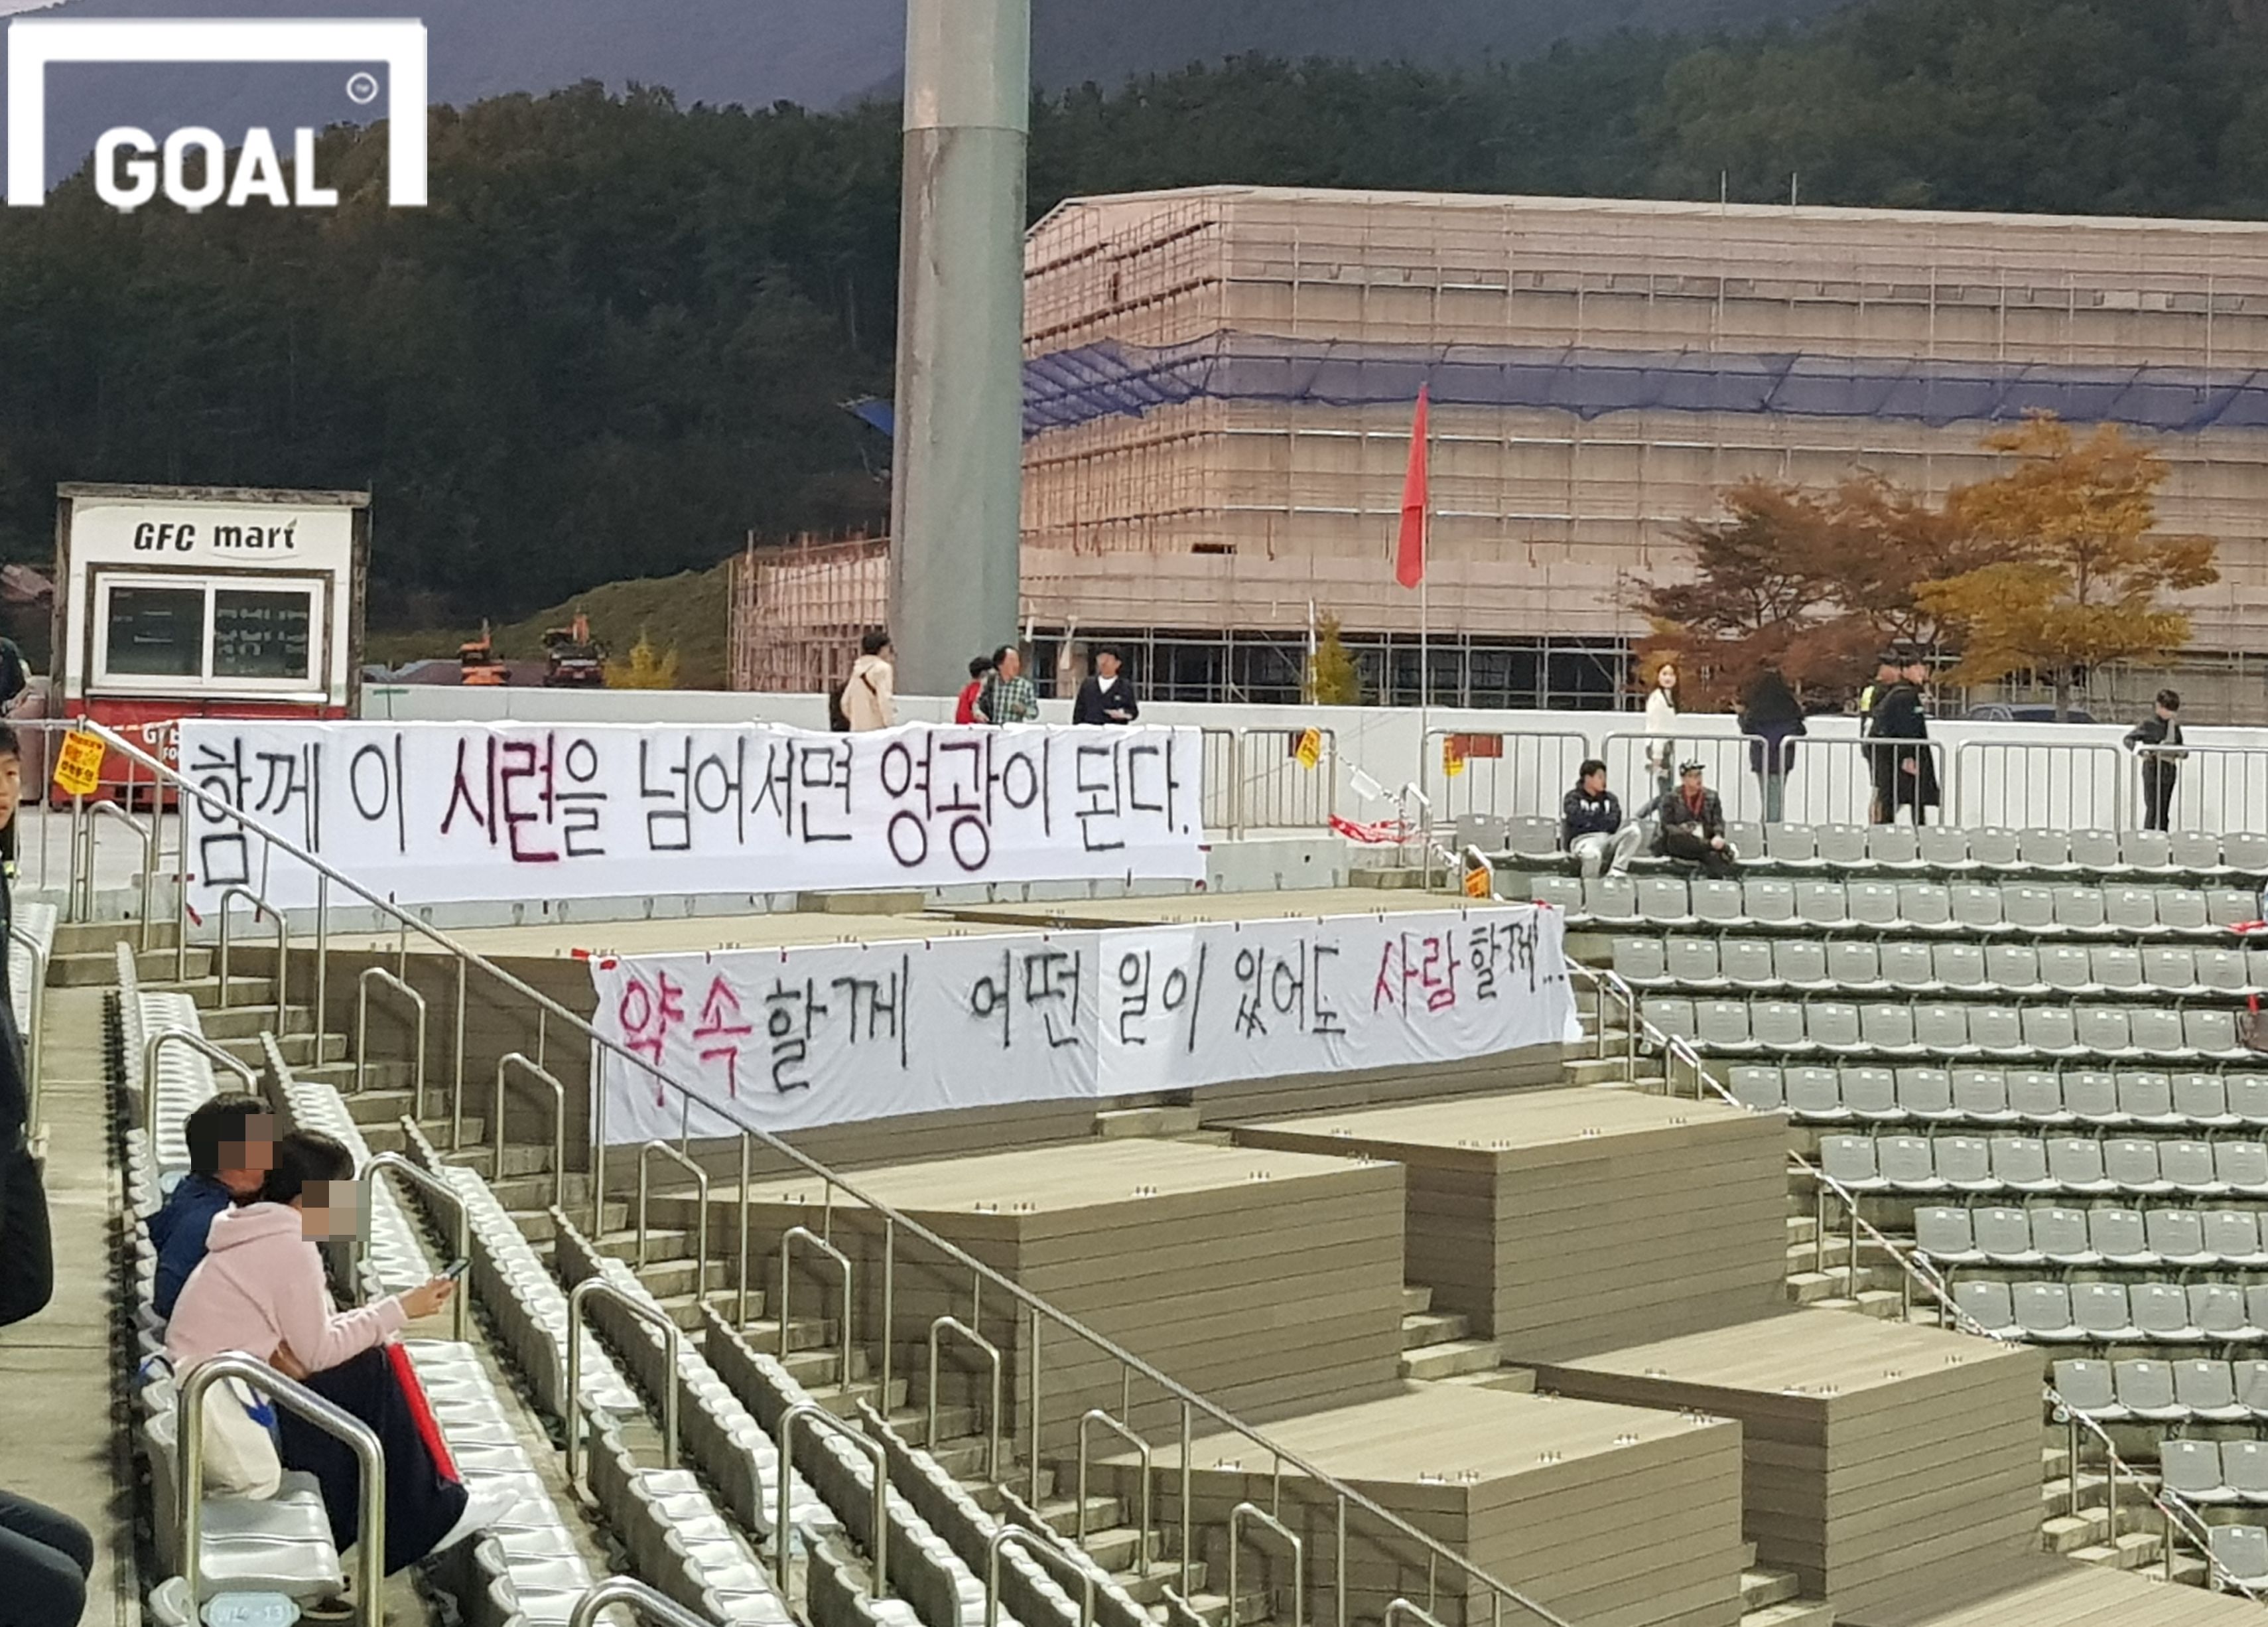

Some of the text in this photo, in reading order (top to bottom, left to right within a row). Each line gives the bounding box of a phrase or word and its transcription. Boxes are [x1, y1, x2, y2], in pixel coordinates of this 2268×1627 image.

[133, 518, 298, 552] GFC mart
[190, 731, 1190, 886] 함께 이 시련을 넘어서면 영광이 된다.
[618, 953, 910, 1108] 약속할께
[970, 949, 1081, 1048] 어떤
[1118, 942, 1207, 1054] 일이
